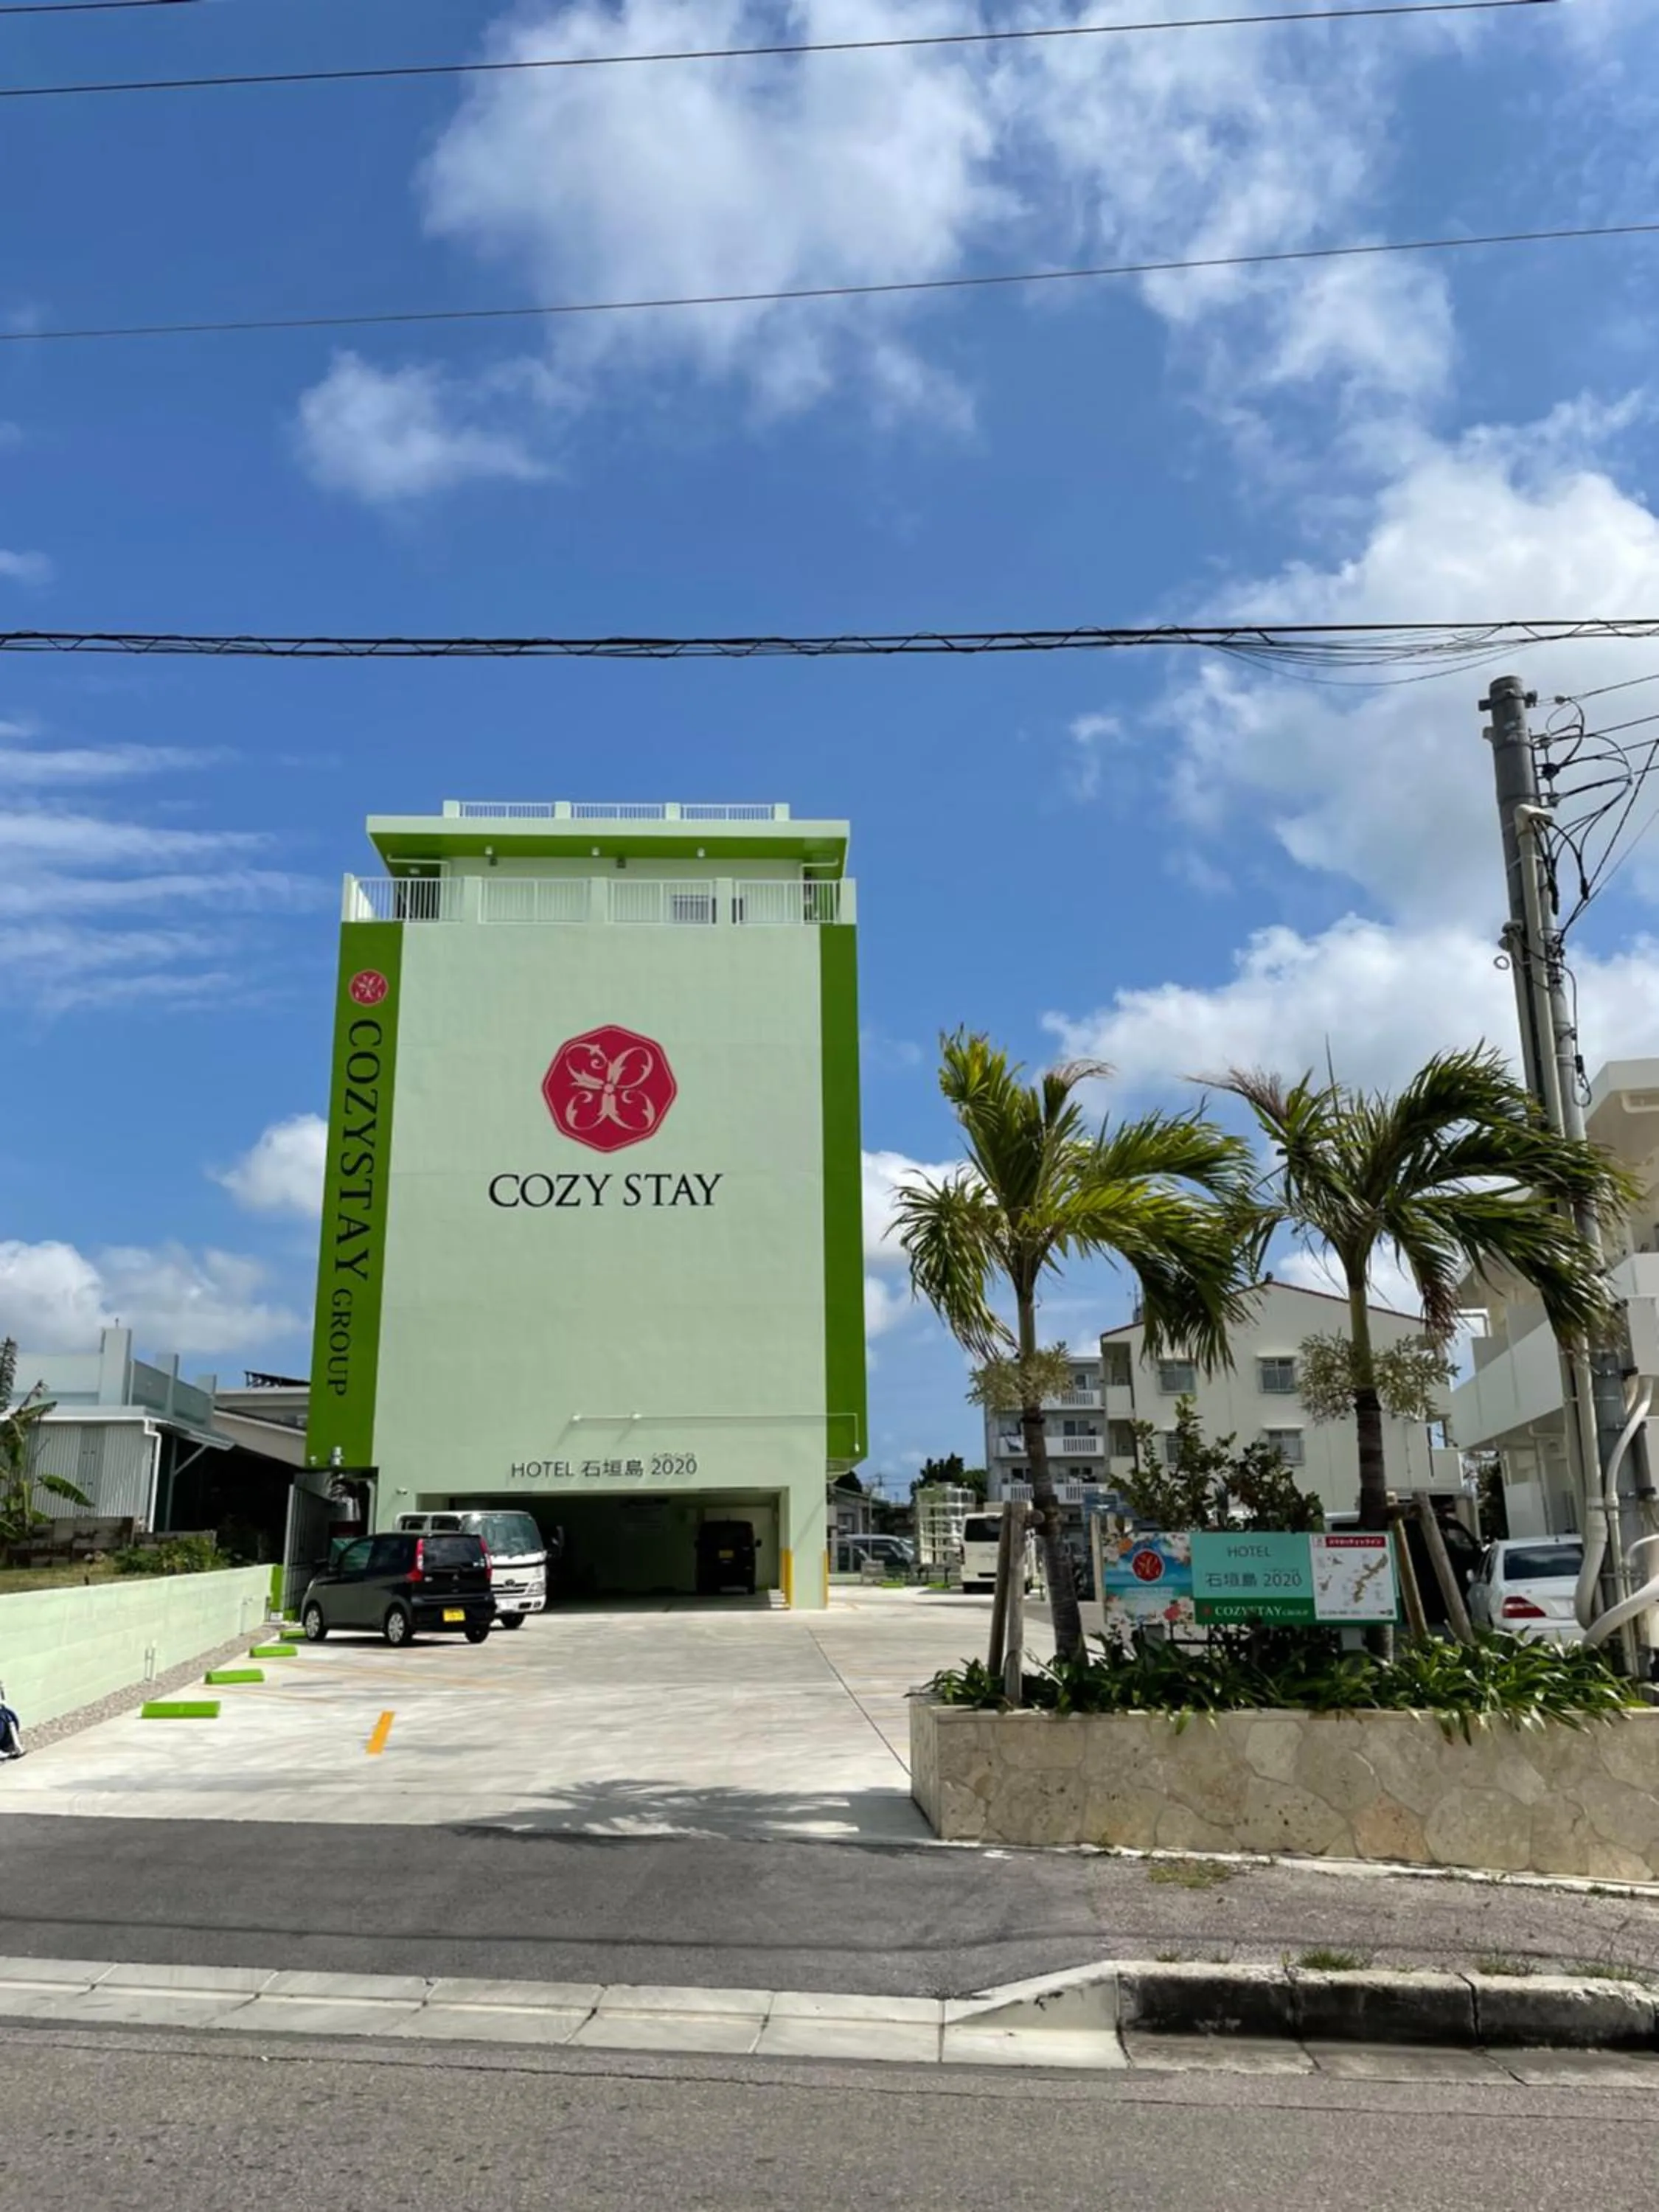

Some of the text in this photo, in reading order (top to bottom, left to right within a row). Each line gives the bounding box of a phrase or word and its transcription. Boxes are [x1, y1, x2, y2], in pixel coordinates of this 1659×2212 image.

[488, 1173, 723, 1207] COZY STAY
[327, 1287, 353, 1397] GROUP
[511, 1458, 698, 1478] HOTEL 石垣島 2020
[1227, 1545, 1272, 1558] HOTEL
[1206, 1571, 1302, 1587] 石垣島 2020
